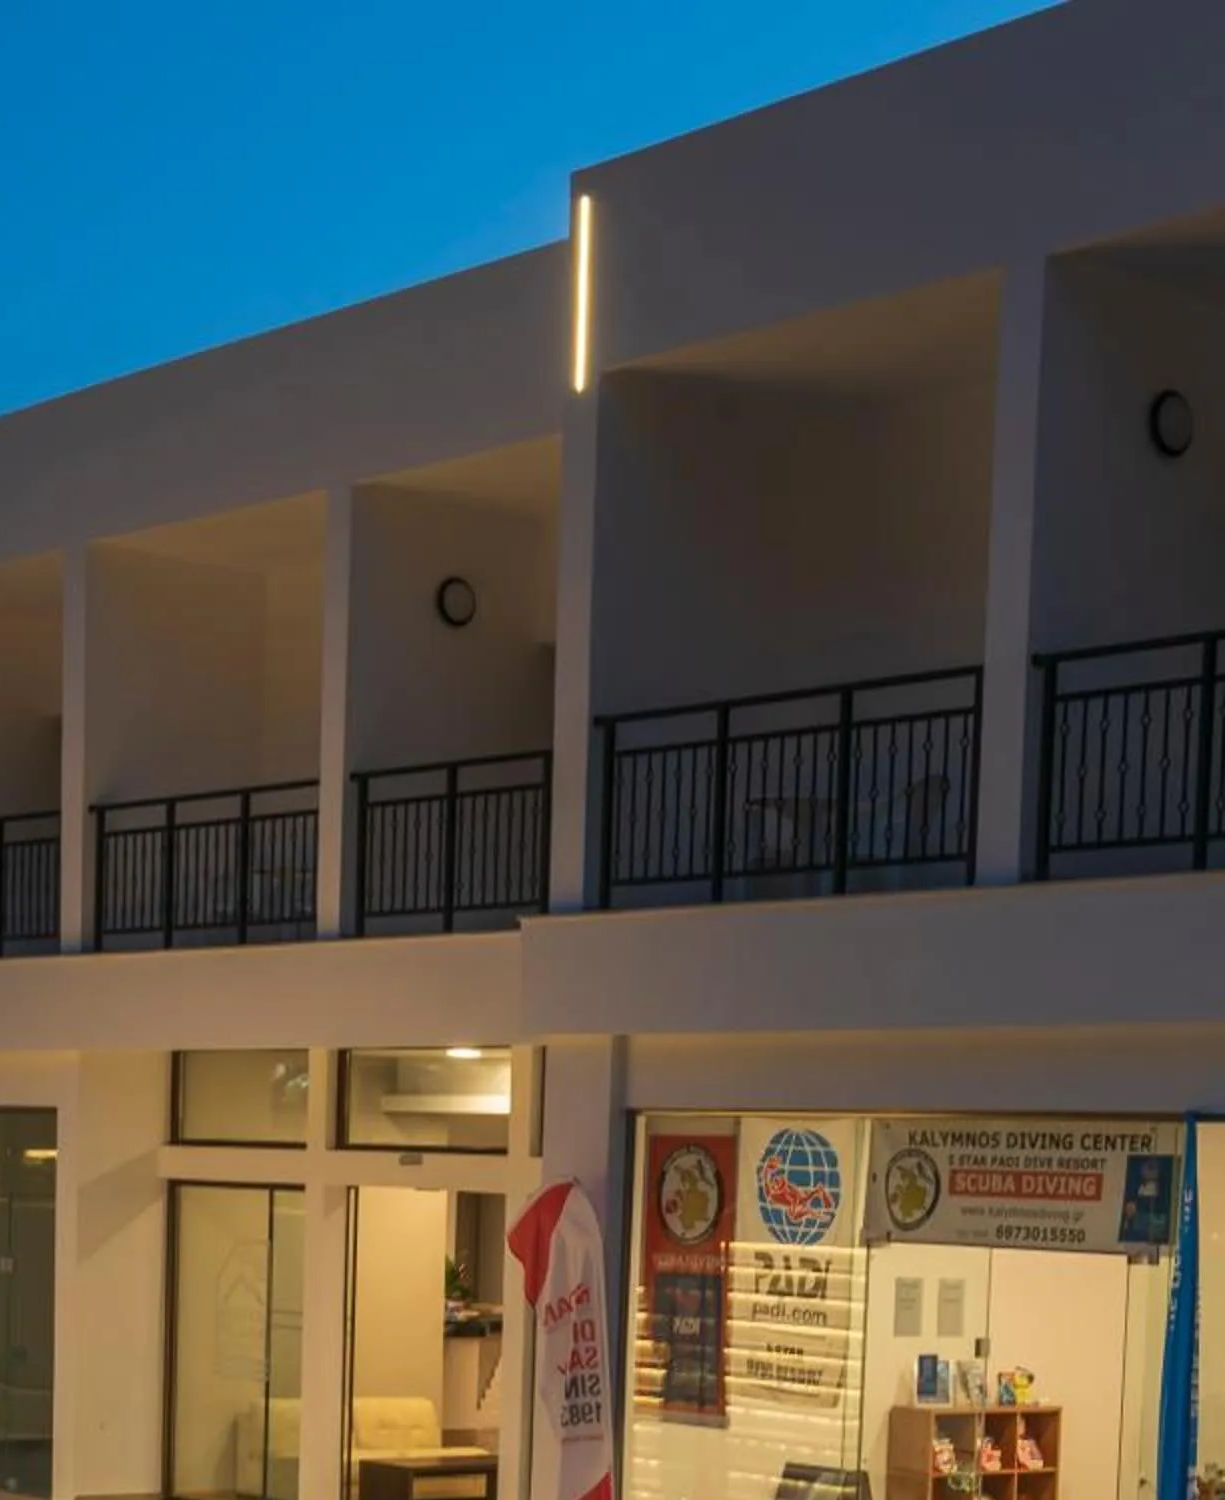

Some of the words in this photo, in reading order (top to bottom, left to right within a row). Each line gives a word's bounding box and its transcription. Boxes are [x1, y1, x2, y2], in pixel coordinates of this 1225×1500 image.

[908, 1130, 1000, 1151] KALYMNOS
[1006, 1132, 1073, 1151] DIVING
[1080, 1132, 1152, 1152] CENTER
[958, 1155, 986, 1167] STAR
[990, 1156, 1020, 1167] PADI
[1023, 1157, 1053, 1168] DIVE
[1056, 1158, 1107, 1170] RESORT
[955, 1173, 1016, 1193] SCUBA
[1021, 1175, 1096, 1196] DIVING
[754, 1251, 832, 1299] PADI
[751, 1300, 827, 1326] padi.com
